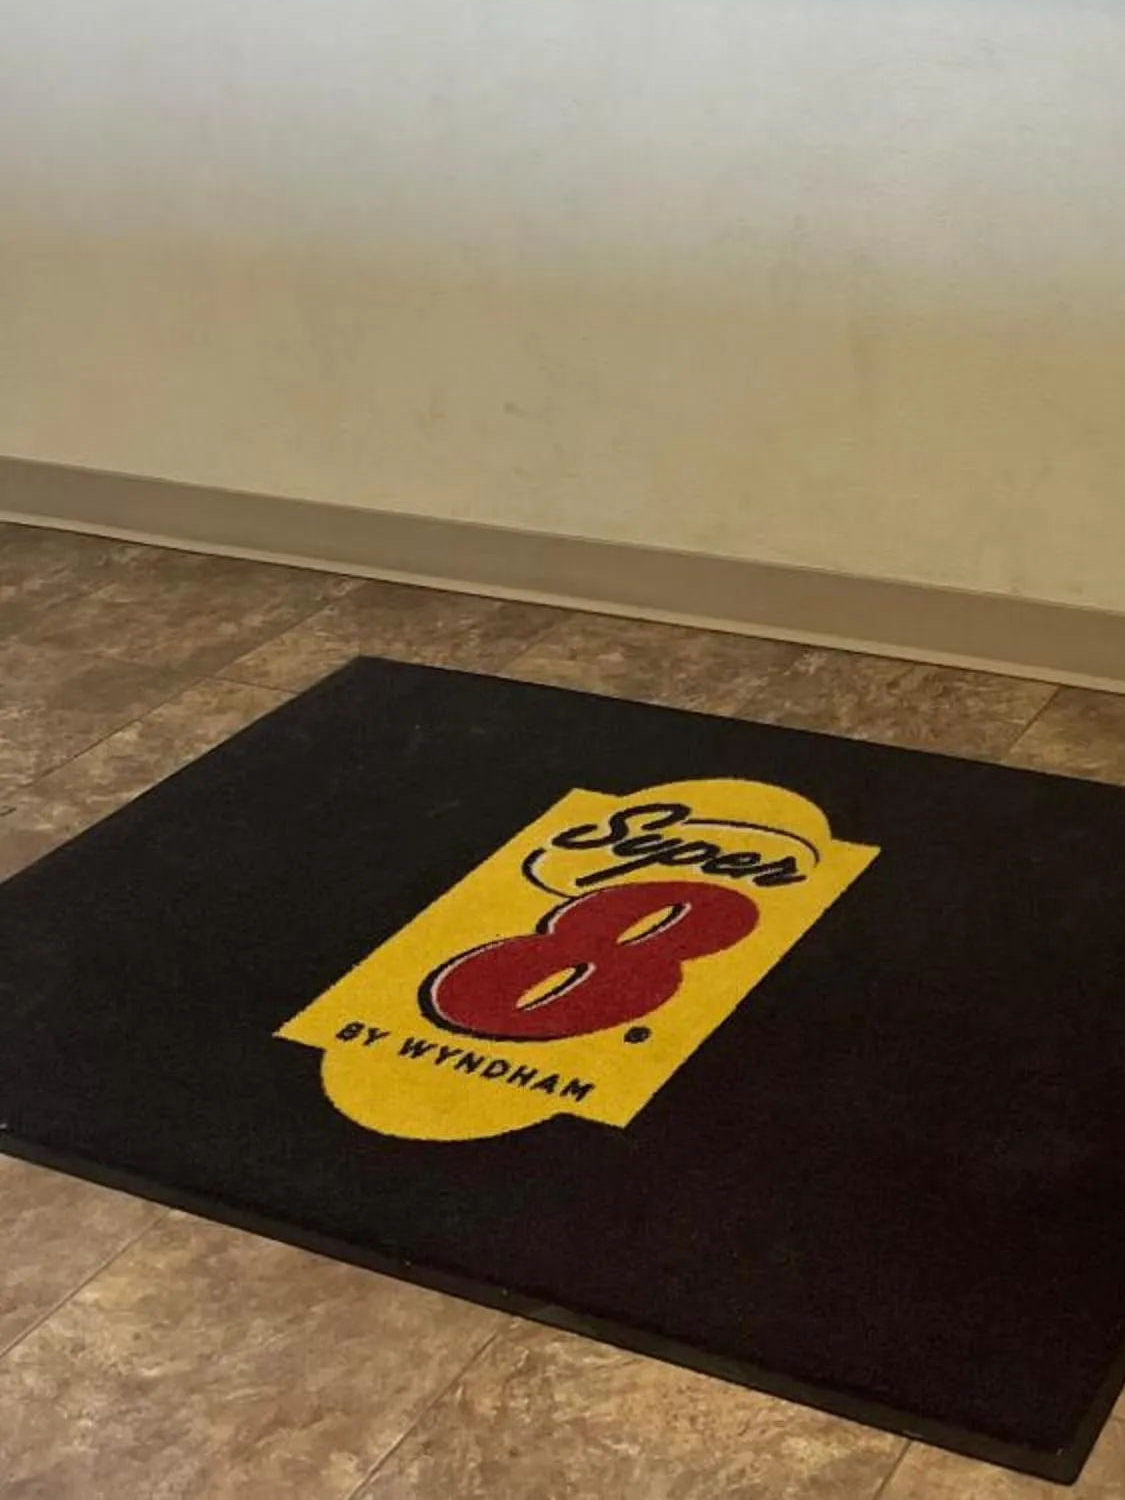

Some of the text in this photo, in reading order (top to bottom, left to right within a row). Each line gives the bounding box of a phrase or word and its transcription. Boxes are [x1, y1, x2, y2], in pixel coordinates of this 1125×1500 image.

[551, 802, 807, 888] Super
[417, 880, 761, 1043] 8
[335, 1021, 597, 1103] BY WYNDHAM
